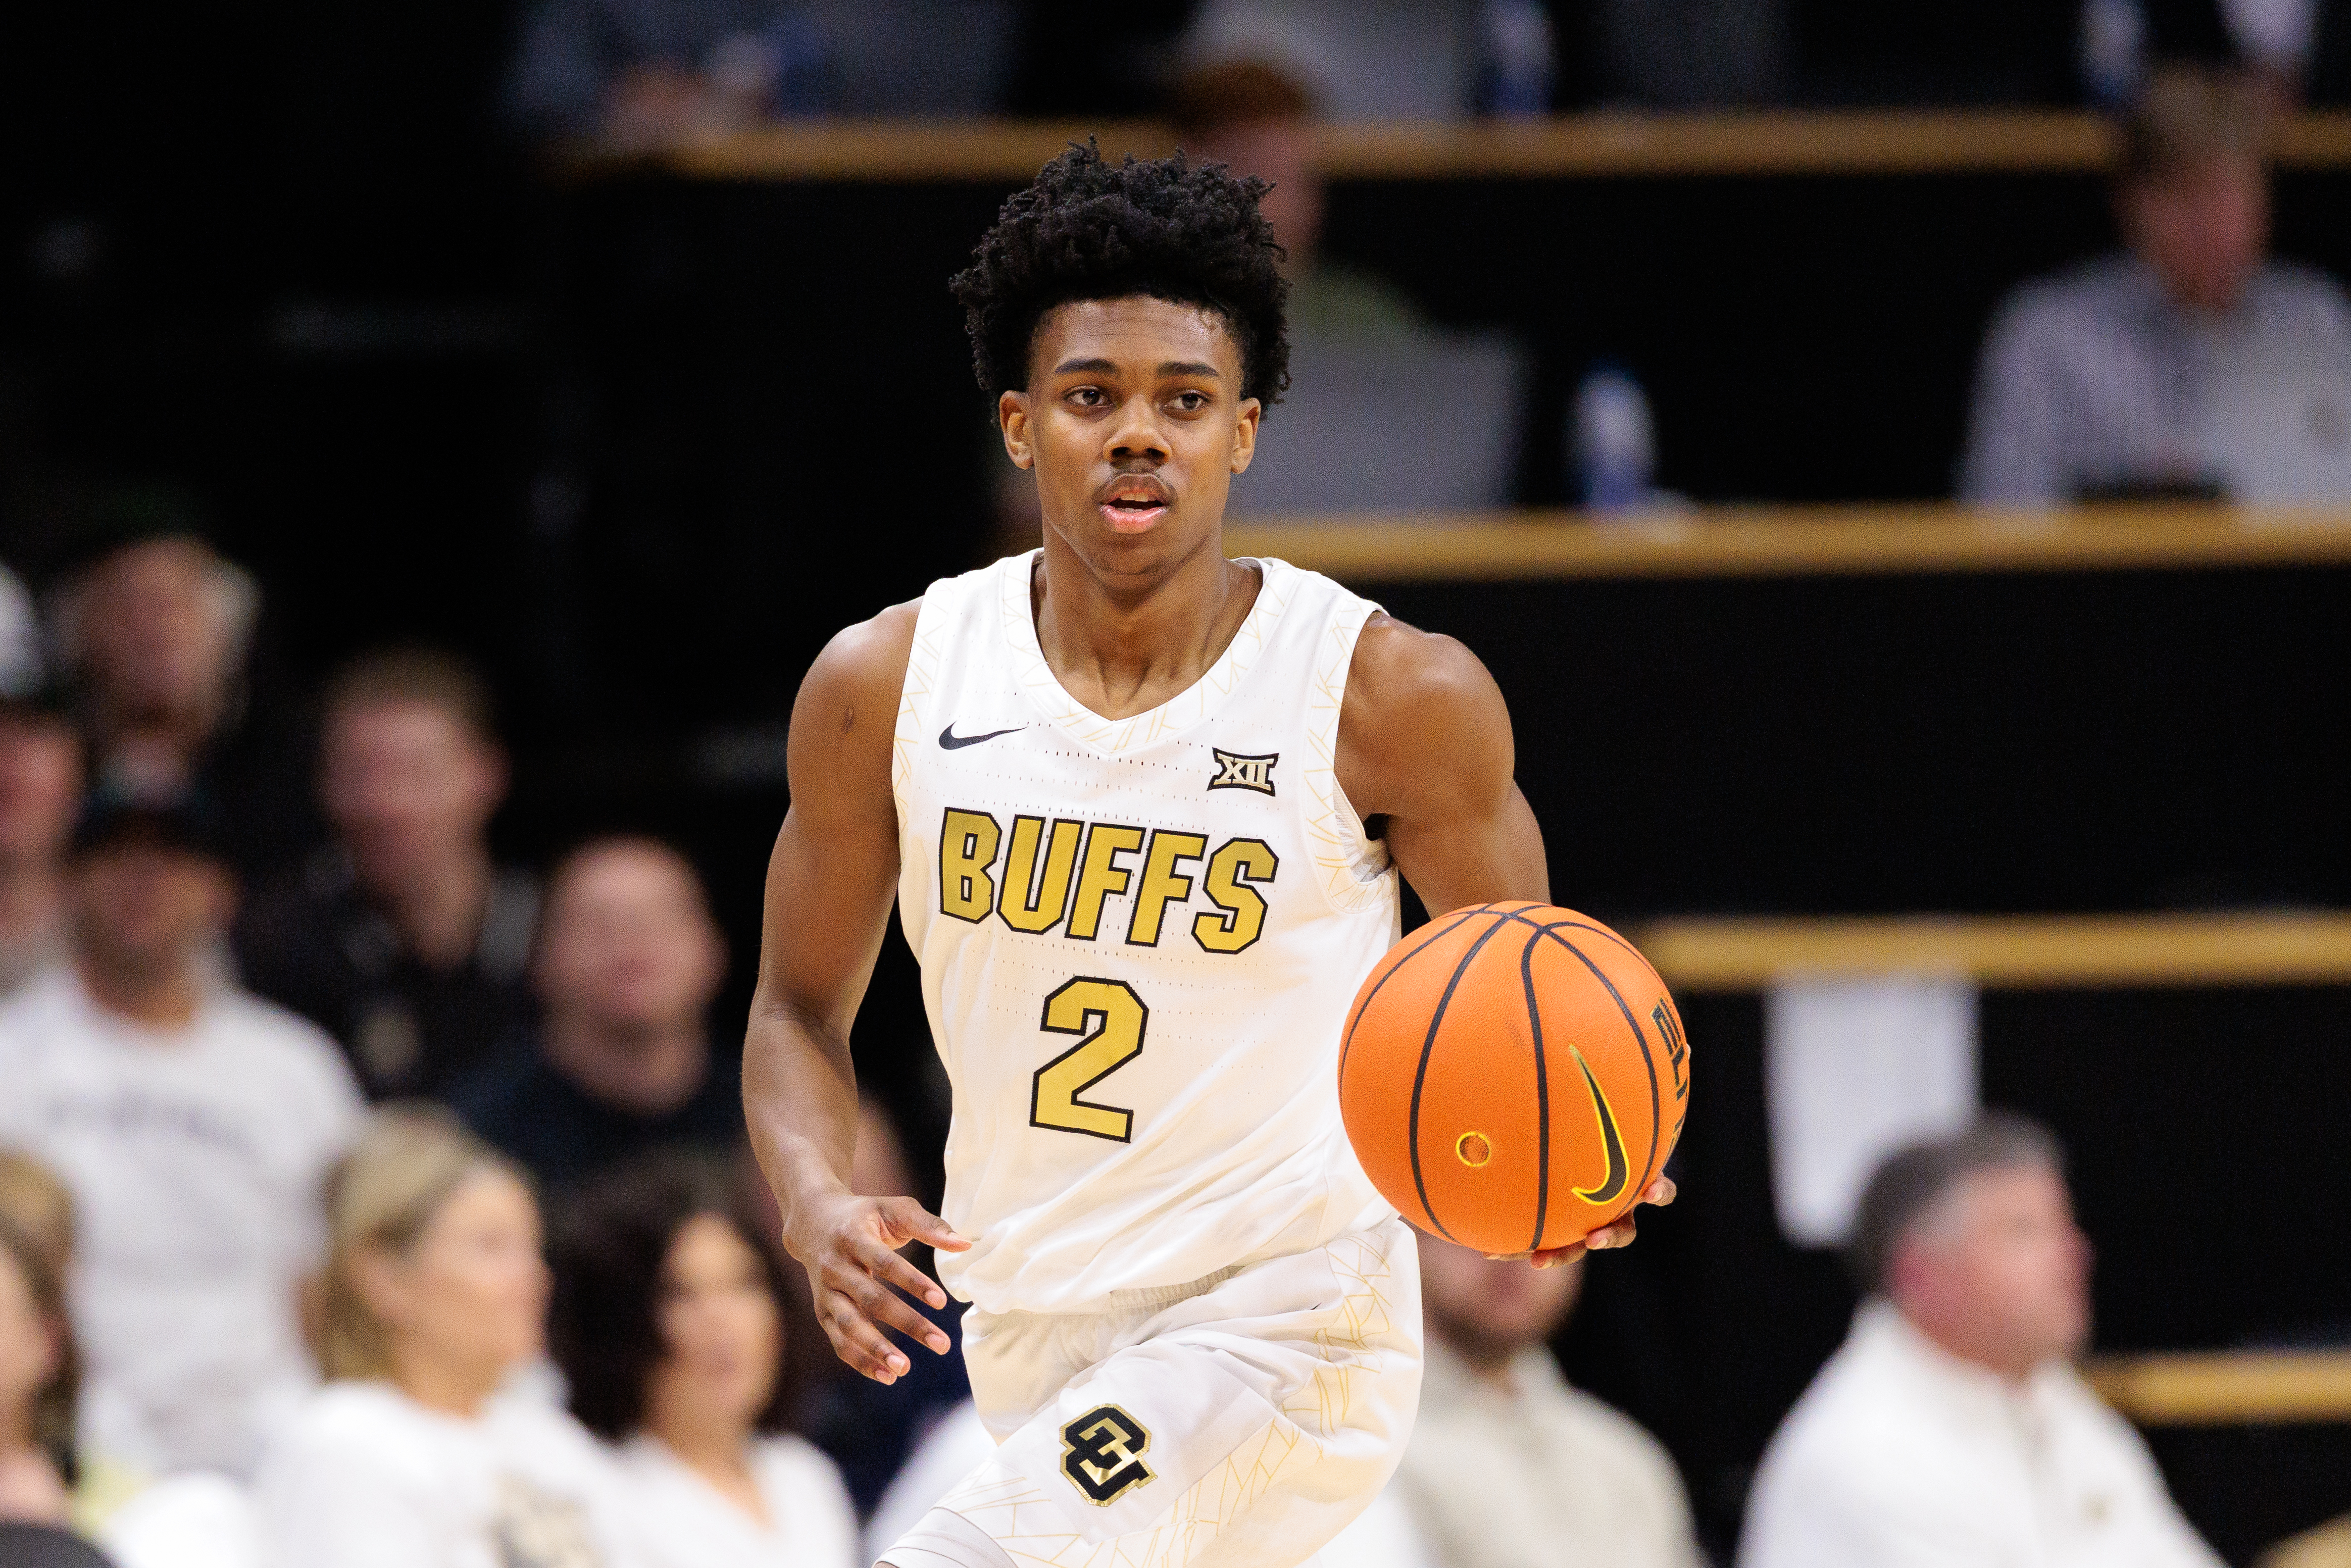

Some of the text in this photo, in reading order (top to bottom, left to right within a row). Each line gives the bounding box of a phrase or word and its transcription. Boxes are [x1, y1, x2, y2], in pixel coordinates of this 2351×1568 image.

[1211, 750, 1277, 794] XII
[938, 806, 1280, 955] BUFFS
[1029, 975, 1149, 1143] 2
